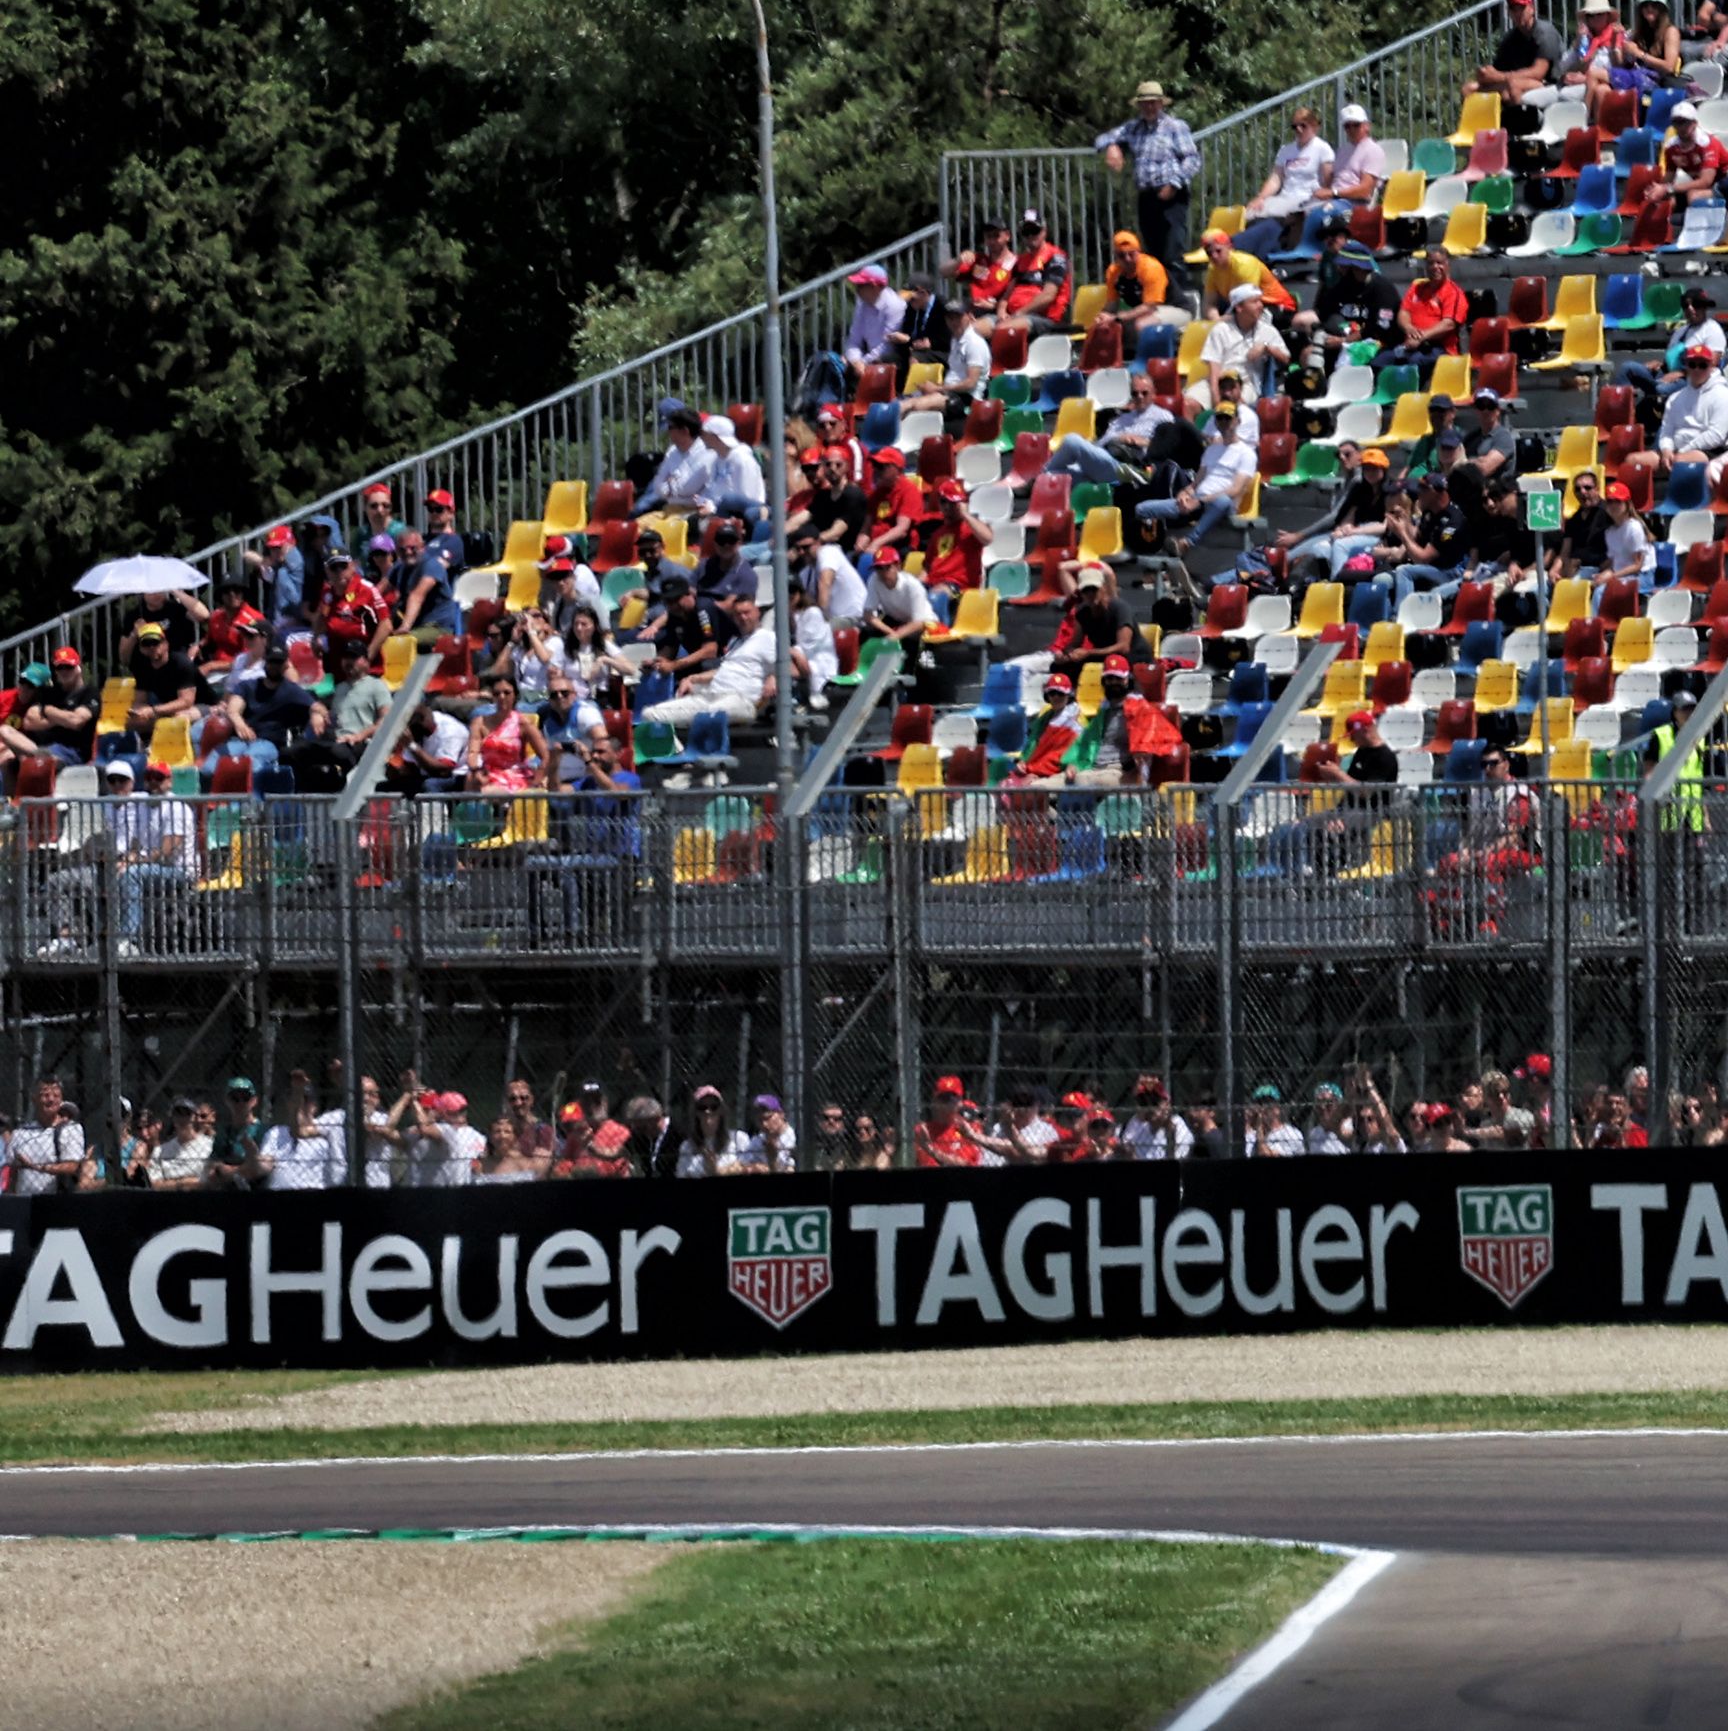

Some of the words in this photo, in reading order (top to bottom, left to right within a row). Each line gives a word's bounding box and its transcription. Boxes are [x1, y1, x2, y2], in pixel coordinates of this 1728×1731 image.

[738, 1215, 821, 1253] TAG
[1467, 1194, 1542, 1232] TAG
[0, 1223, 680, 1349] AGHeuer
[735, 1262, 826, 1317] HEUER
[1467, 1243, 1548, 1298] HEUER
